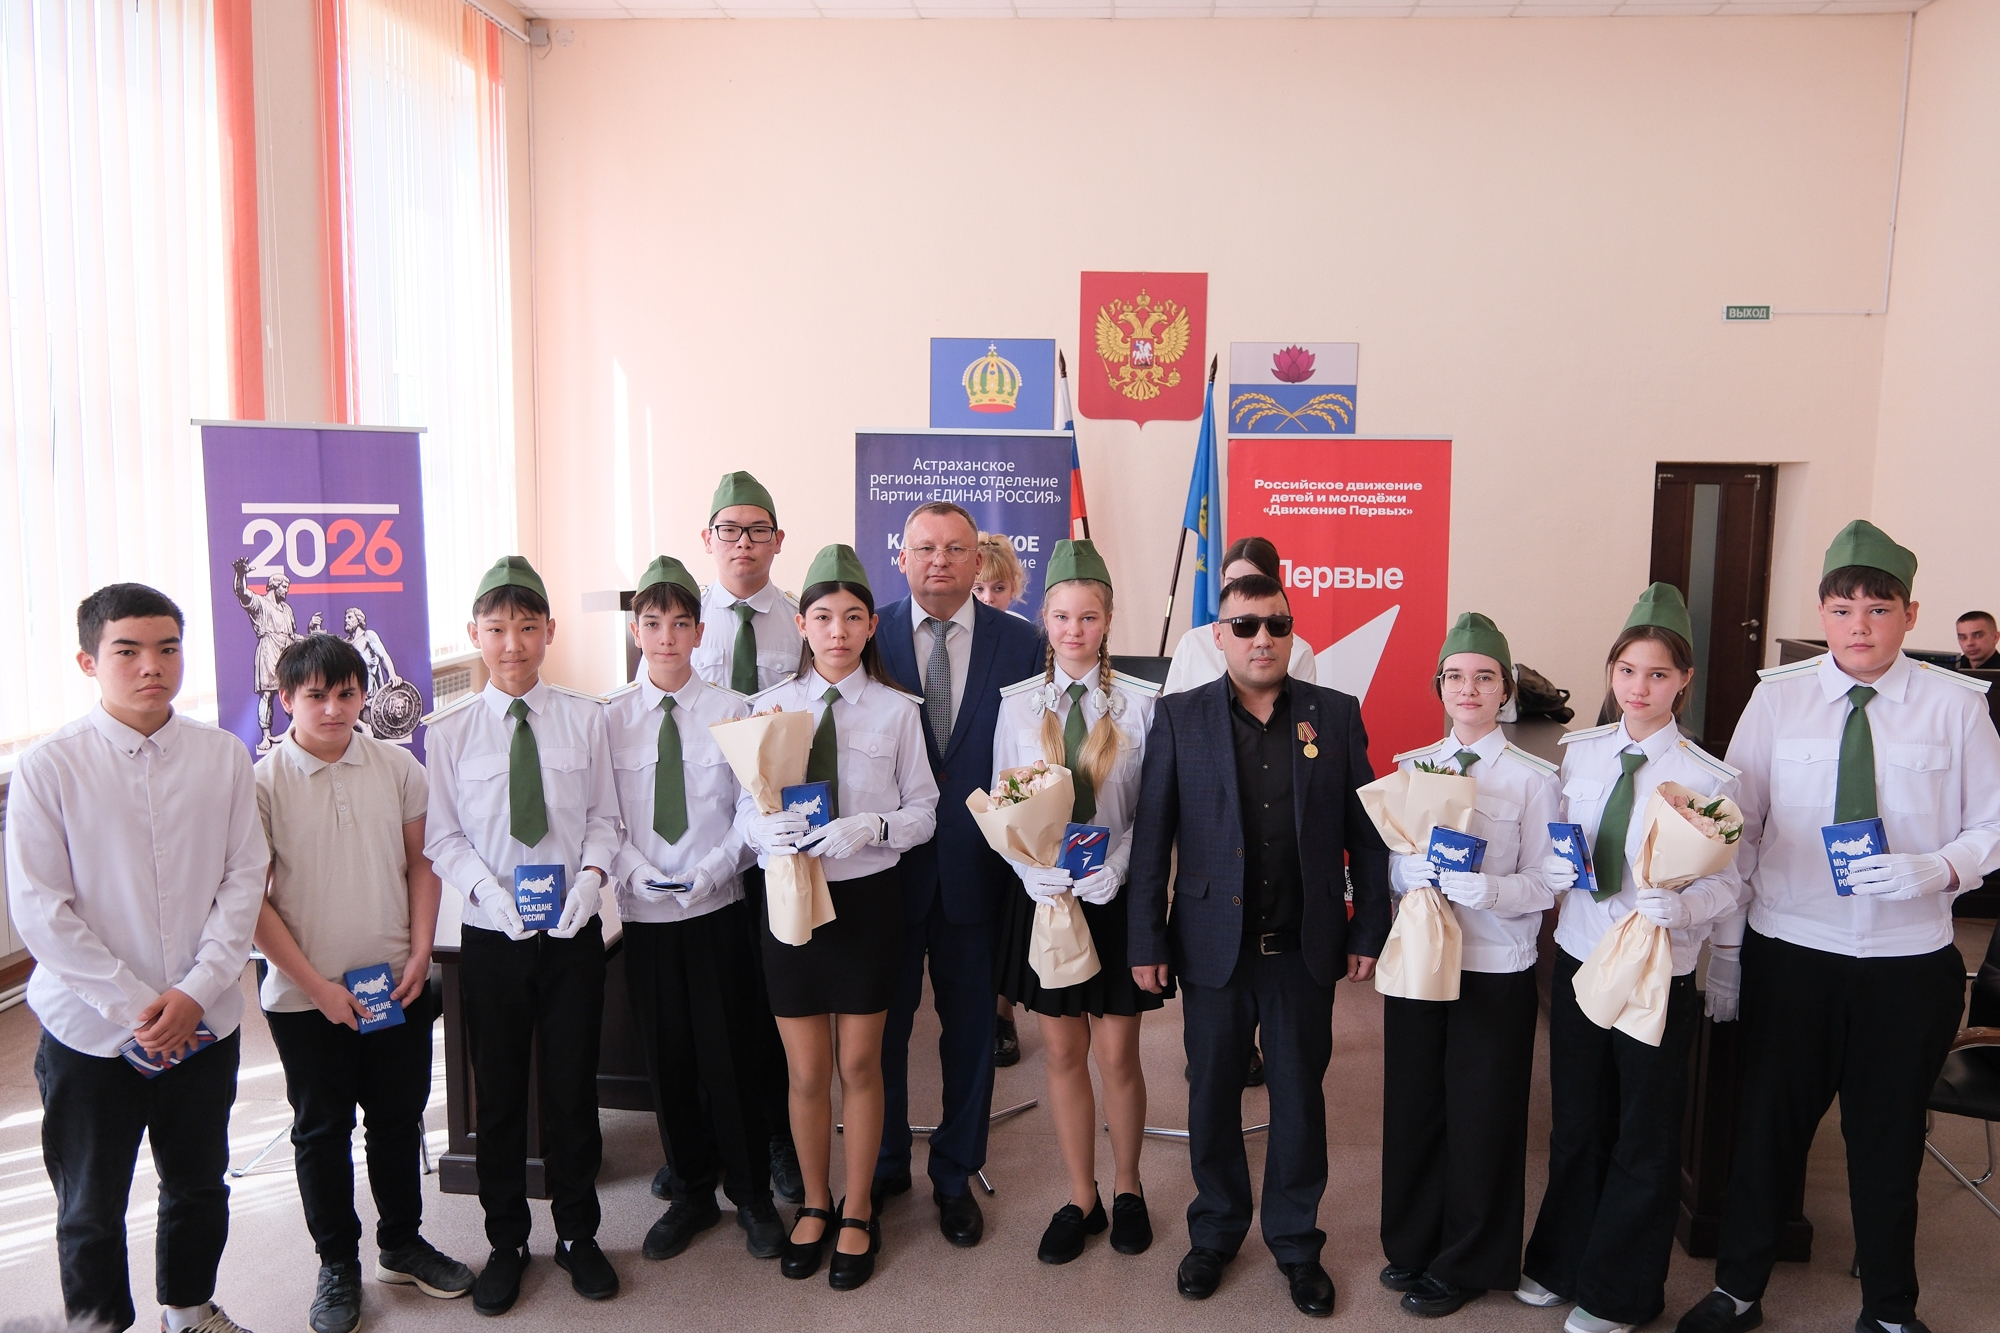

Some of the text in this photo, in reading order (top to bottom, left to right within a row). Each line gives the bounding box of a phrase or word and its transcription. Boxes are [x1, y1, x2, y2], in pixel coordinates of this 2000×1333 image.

[1729, 308, 1767, 318] ВЫХОД
[913, 458, 1015, 473] Астраханское
[870, 473, 1059, 488] региональное отделение
[1254, 479, 1423, 492] Российское движение
[870, 488, 1062, 504] Партии «ЕДИНАЯ РОССИЯ»
[1270, 491, 1407, 504] детей и молодёжи
[1263, 504, 1413, 517] «Движение Первых»
[242, 518, 403, 578] 2026
[1430, 855, 1441, 864] МЫ
[1833, 858, 1847, 867] МЫ
[519, 895, 530, 903] МЫ
[519, 903, 553, 913] ГРАЖДАНЕ
